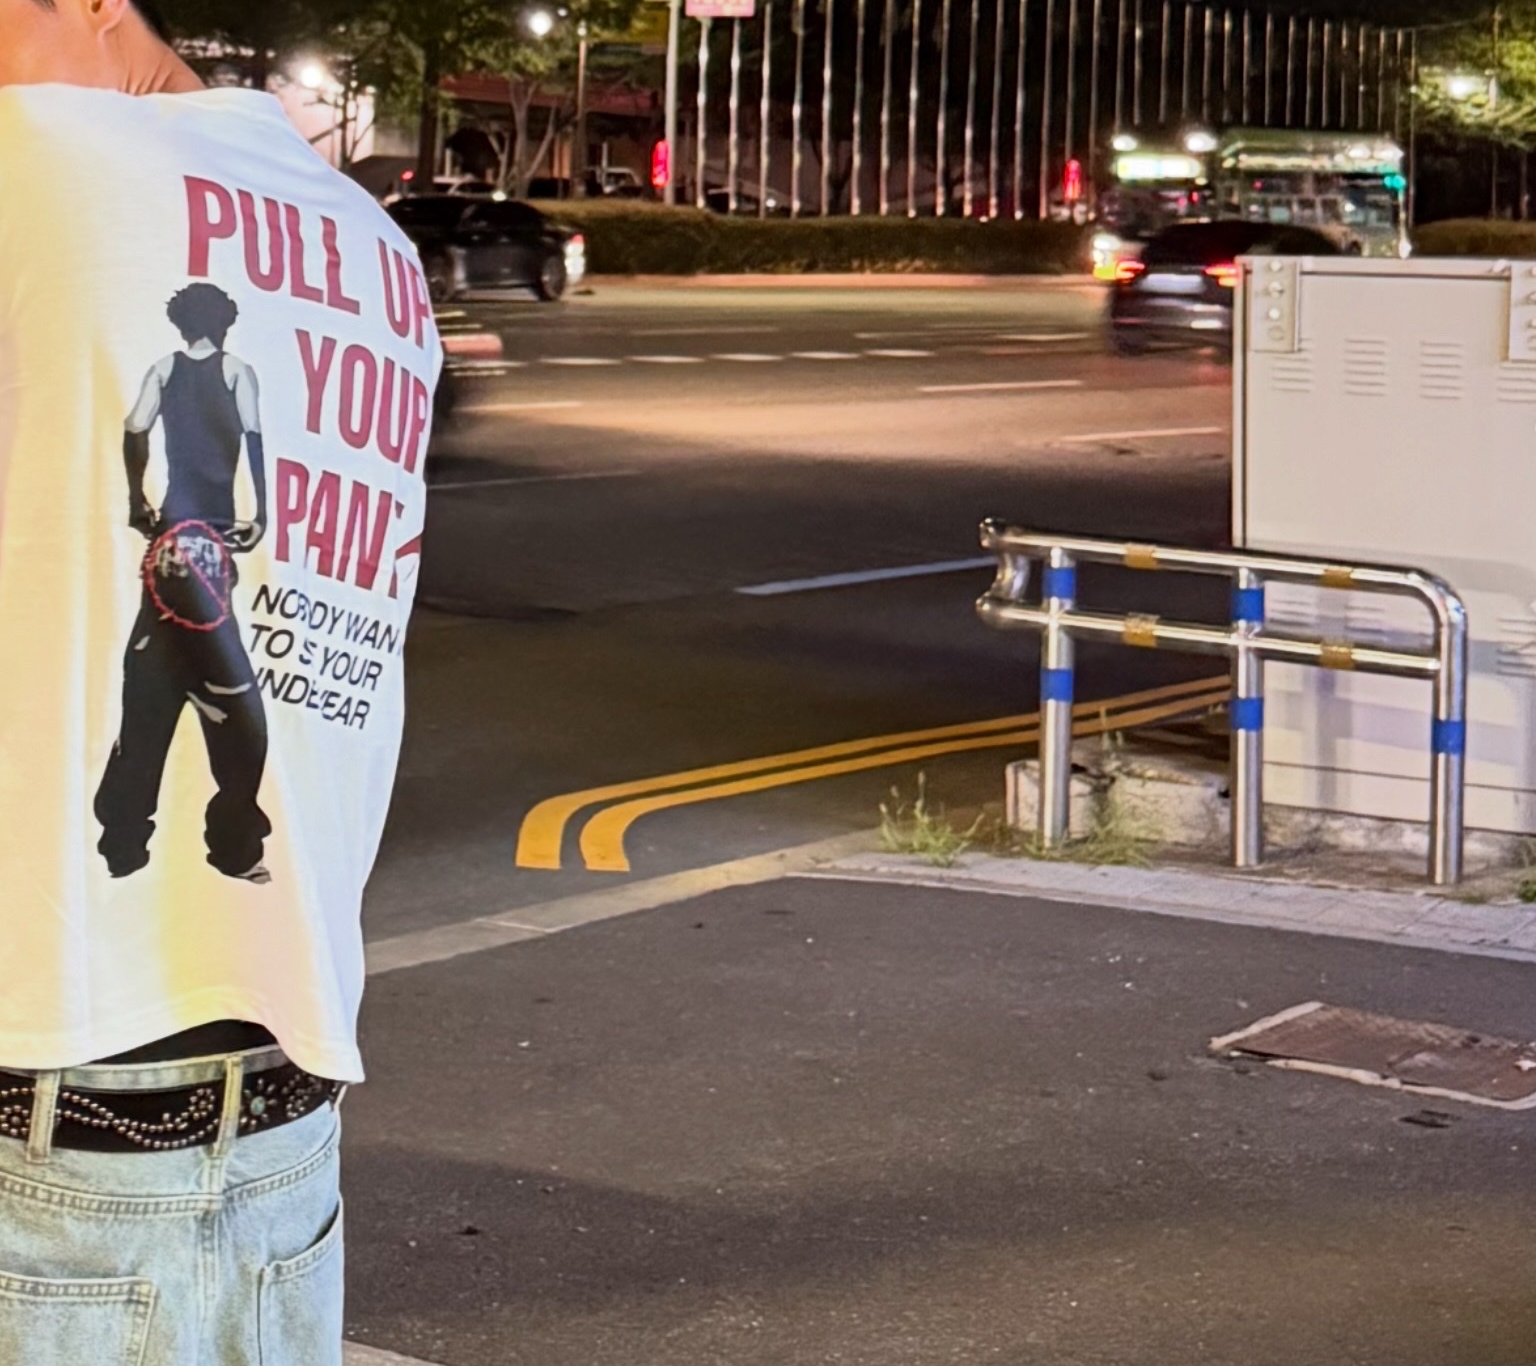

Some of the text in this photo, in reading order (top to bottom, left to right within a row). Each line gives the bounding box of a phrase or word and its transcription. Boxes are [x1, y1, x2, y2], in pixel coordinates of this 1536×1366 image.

[183, 174, 430, 350] PULL UP
[250, 623, 295, 659] TO
[319, 646, 383, 691] YOUR
[344, 611, 402, 656] WAN
